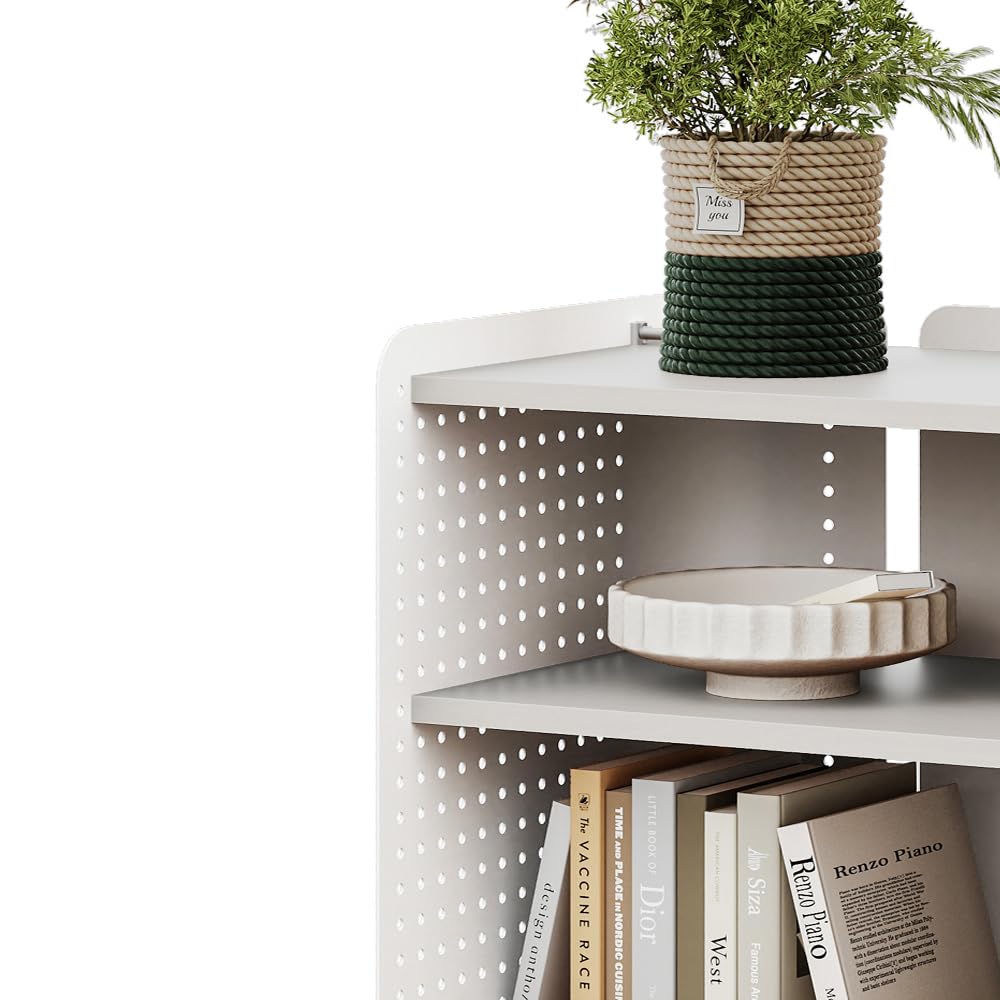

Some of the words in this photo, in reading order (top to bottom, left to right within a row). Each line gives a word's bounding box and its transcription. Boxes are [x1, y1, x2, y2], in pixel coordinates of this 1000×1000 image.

[705, 195, 732, 208] Miss
[708, 212, 729, 222] you
[580, 817, 590, 834] The
[614, 807, 624, 840] TIME
[614, 840, 622, 859] AND
[833, 858, 888, 880] Renzo
[893, 842, 942, 862] Piano
[578, 840, 590, 928] VACCINE
[614, 860, 624, 902] PLACE
[748, 878, 766, 915] Siza
[790, 856, 816, 908] Renzo
[532, 882, 554, 940] design
[614, 903, 622, 912] IN
[640, 883, 664, 944] Dior
[614, 912, 624, 960] NORDIC
[802, 910, 828, 960] Piano
[579, 940, 590, 990] RACE
[710, 936, 728, 985] West
[750, 942, 760, 984] Famous
